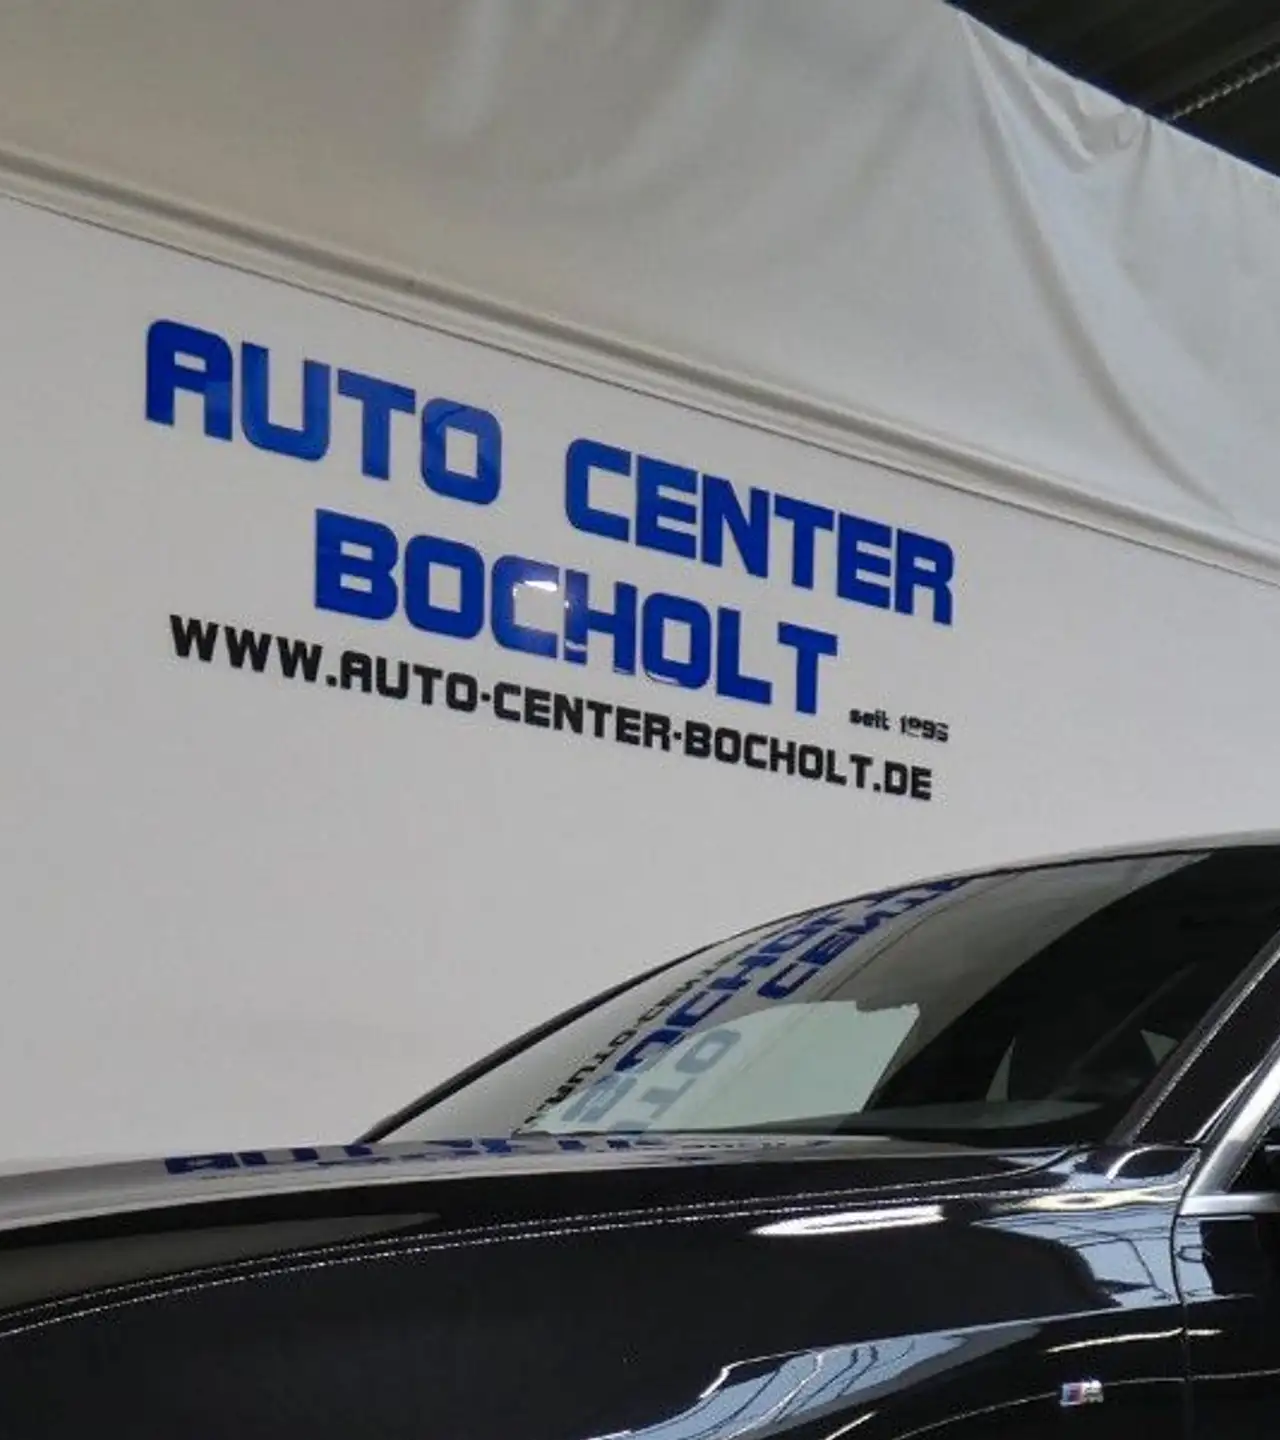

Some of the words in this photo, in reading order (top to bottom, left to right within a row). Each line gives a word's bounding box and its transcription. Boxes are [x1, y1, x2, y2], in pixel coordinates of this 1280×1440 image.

[145, 319, 502, 506] AUTO
[564, 437, 956, 627] CENTER
[314, 508, 839, 716] BOCHOLT
